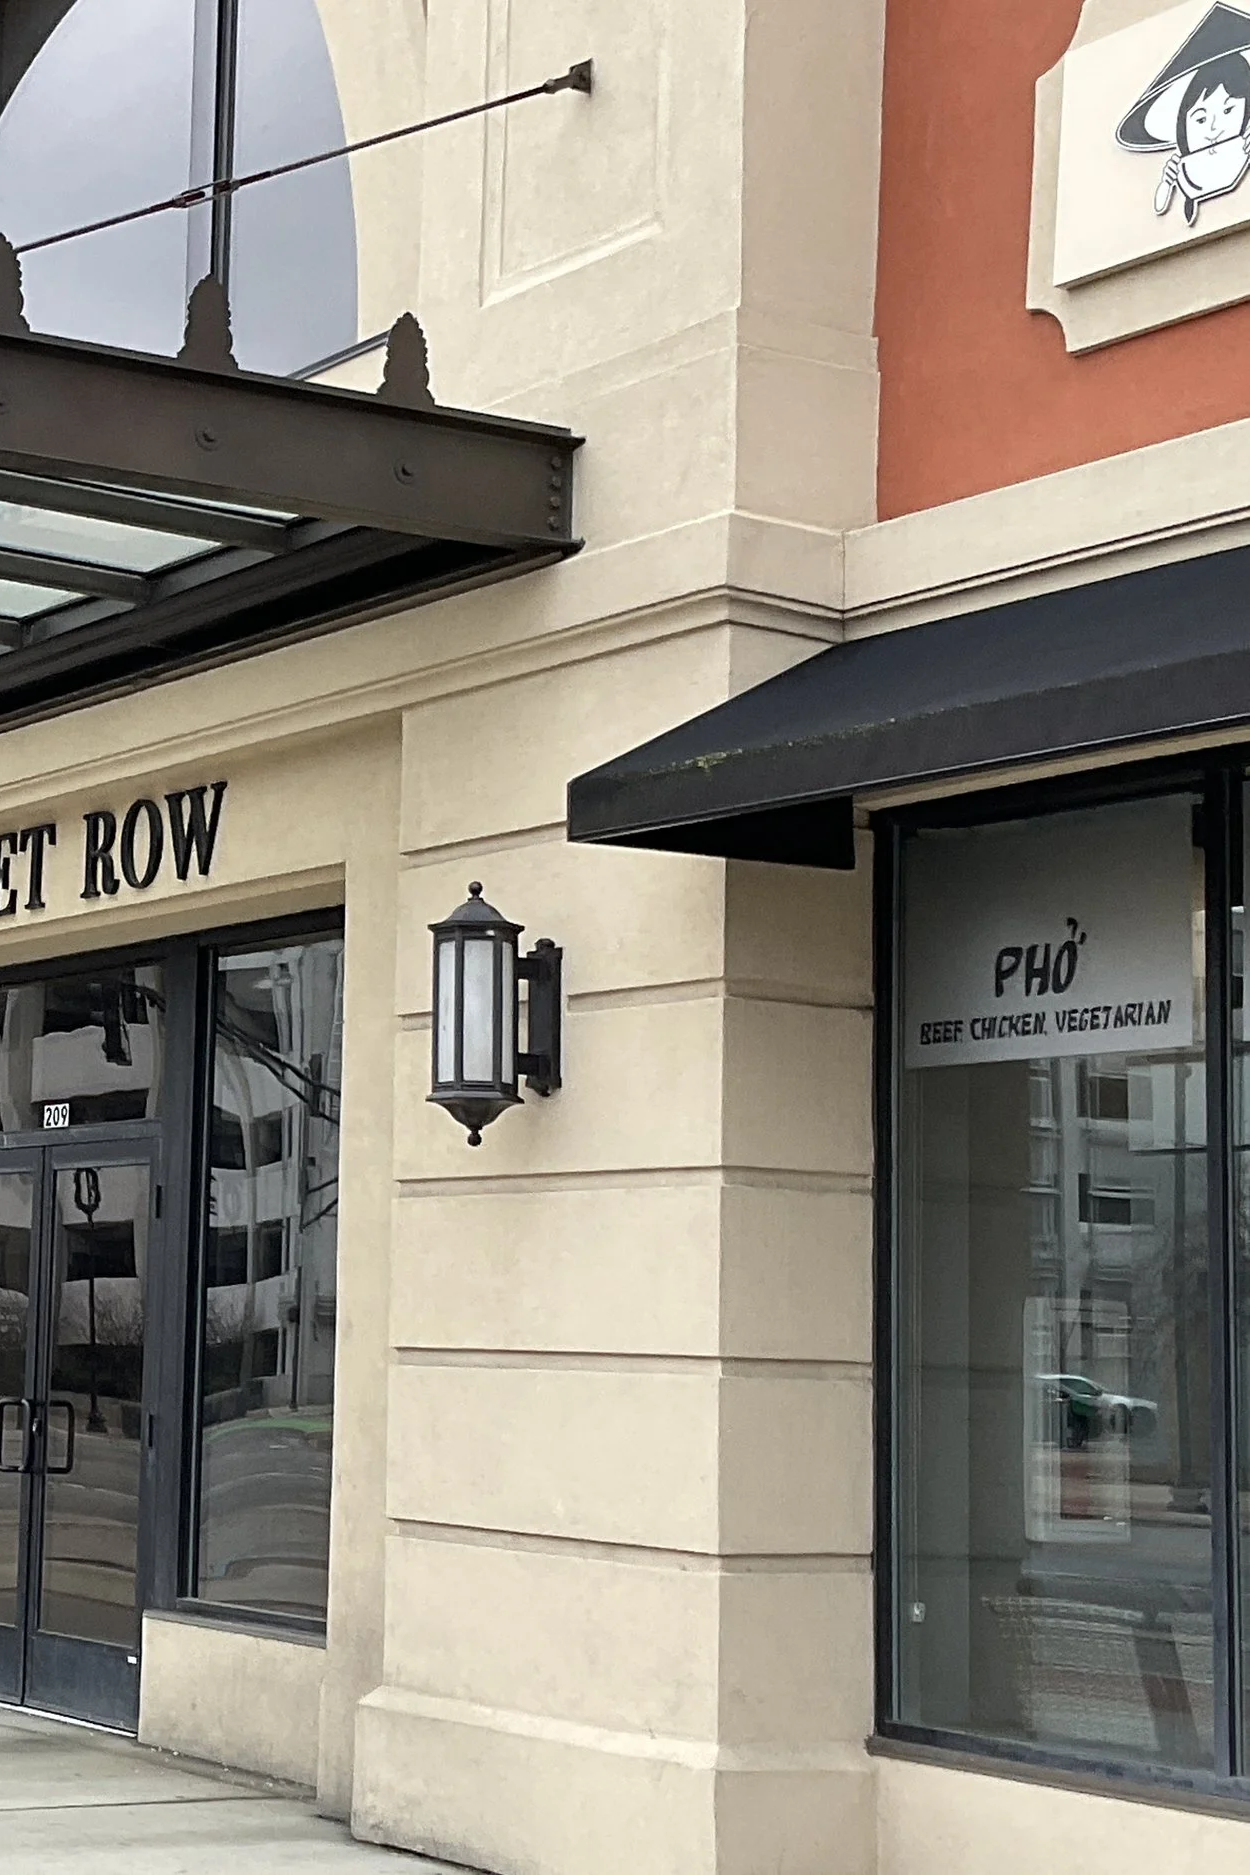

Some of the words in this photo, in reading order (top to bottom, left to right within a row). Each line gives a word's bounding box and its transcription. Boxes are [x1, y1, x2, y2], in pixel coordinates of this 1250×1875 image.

[80, 781, 228, 899] ROW
[1056, 1000, 1172, 1034] VEGETARIAN
[45, 1104, 69, 1127] 209
